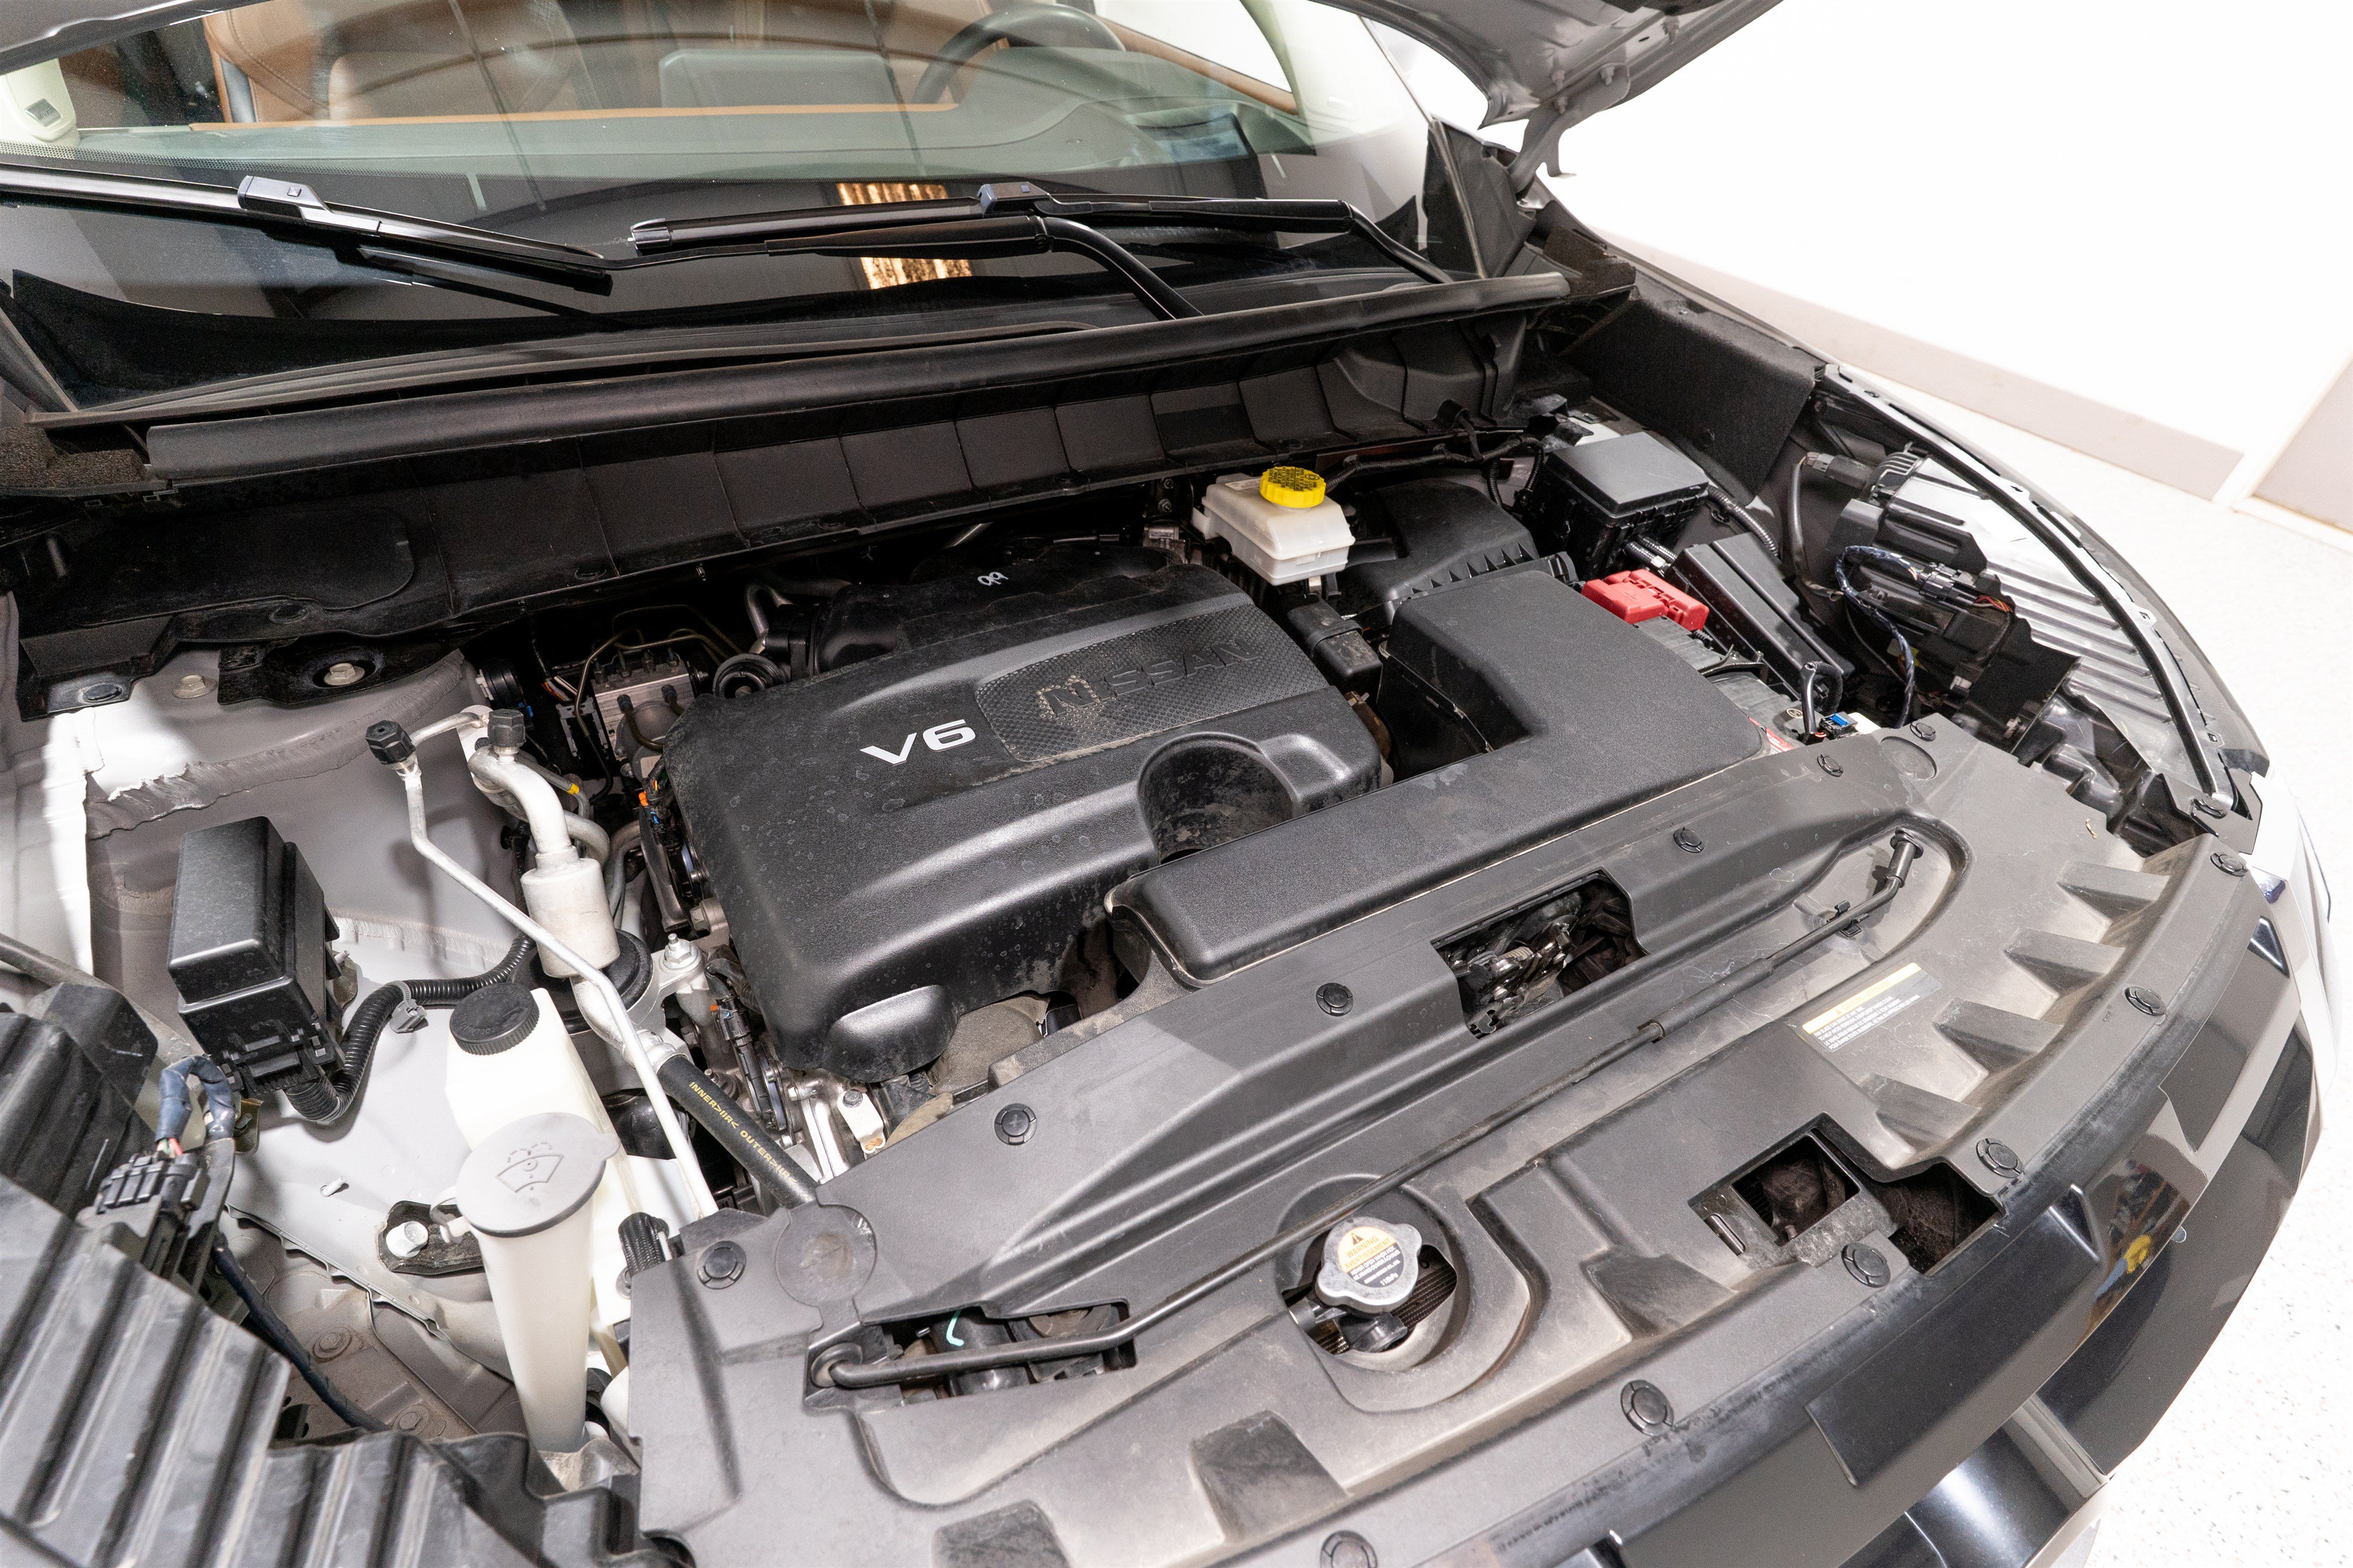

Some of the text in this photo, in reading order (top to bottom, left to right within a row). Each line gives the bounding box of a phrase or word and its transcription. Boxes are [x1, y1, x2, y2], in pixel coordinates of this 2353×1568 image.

[1042, 639, 1259, 715] NISSAN
[860, 719, 976, 766] V6
[1345, 1235, 1378, 1258] WARNING
[1345, 1238, 1391, 1268] AVERTISSEMENT
[1363, 1258, 1376, 1268] OPEN
[1374, 1251, 1387, 1261] WHEN
